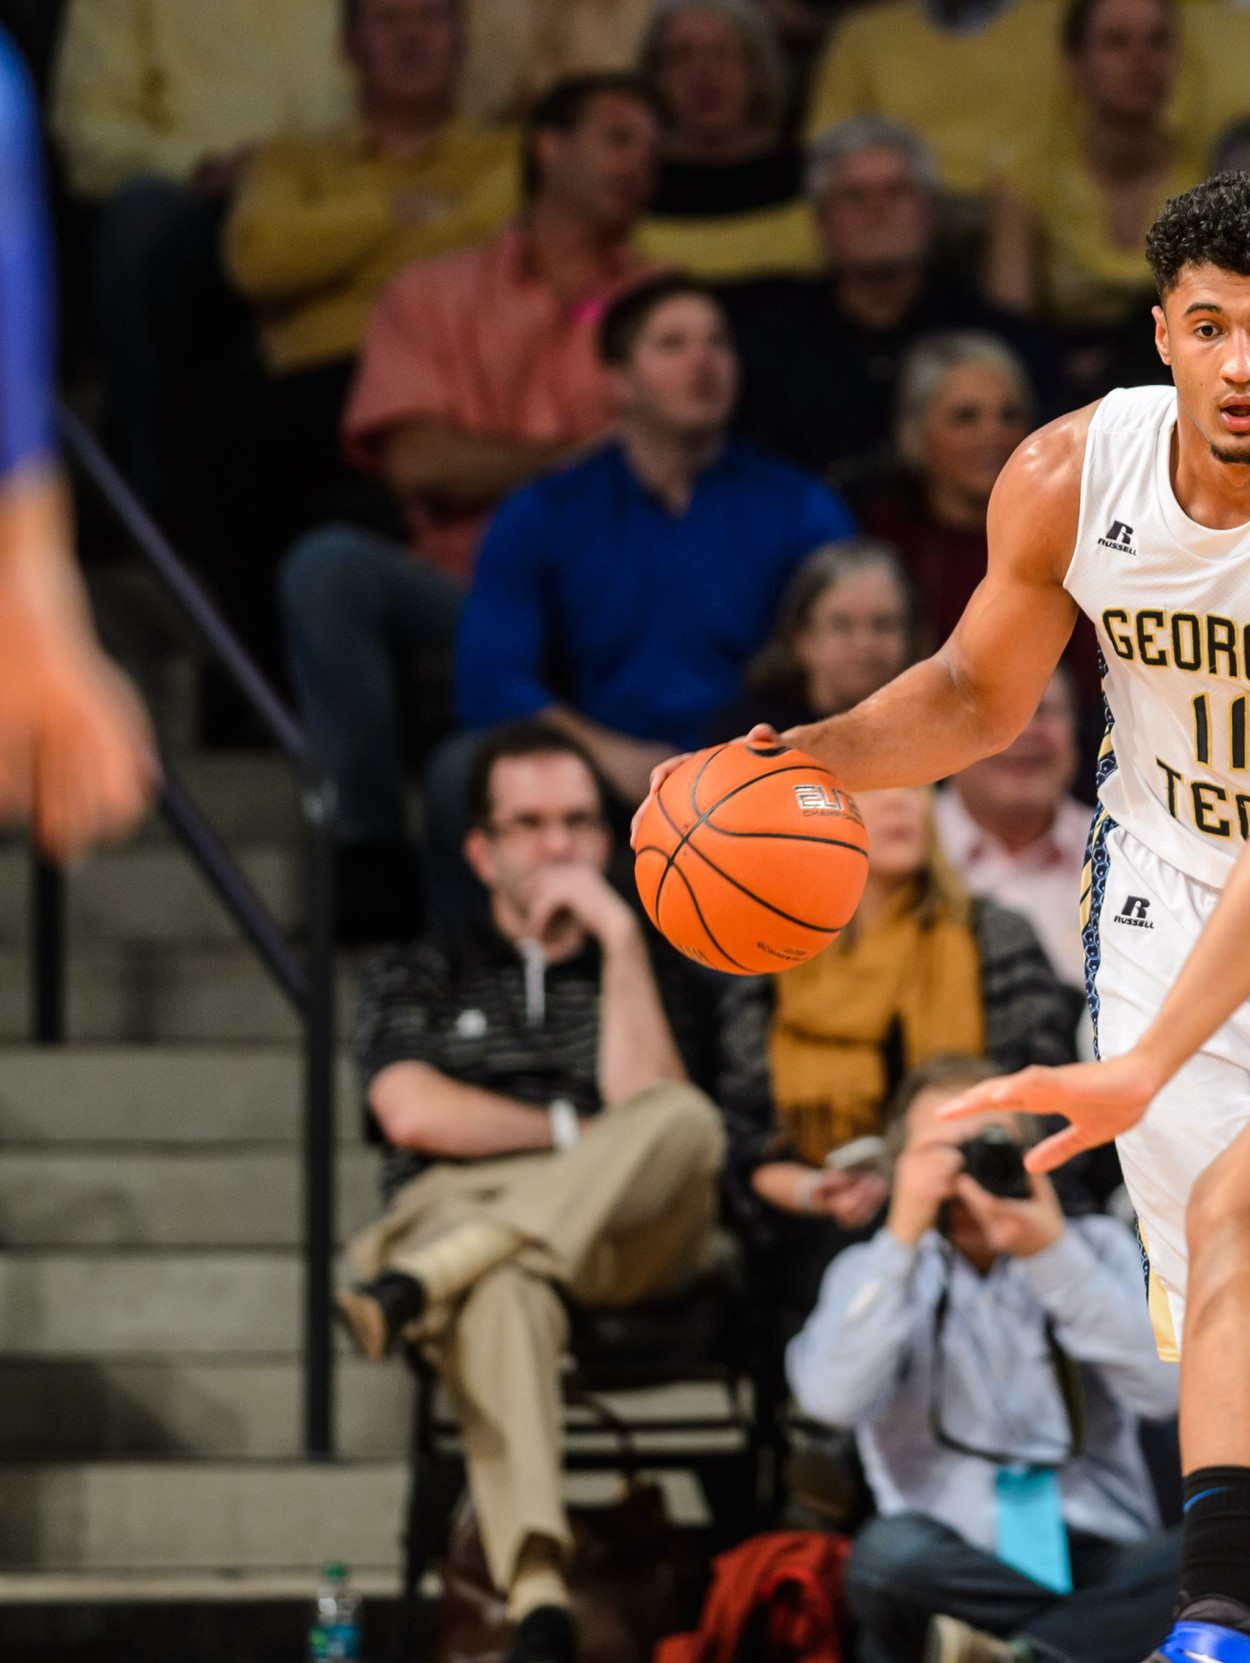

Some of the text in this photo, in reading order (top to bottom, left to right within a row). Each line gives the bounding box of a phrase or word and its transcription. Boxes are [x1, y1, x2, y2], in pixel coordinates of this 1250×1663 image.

[1097, 537, 1137, 556] RUSSELL
[1191, 690, 1250, 772] 11
[1113, 914, 1155, 930] RUSSELL
